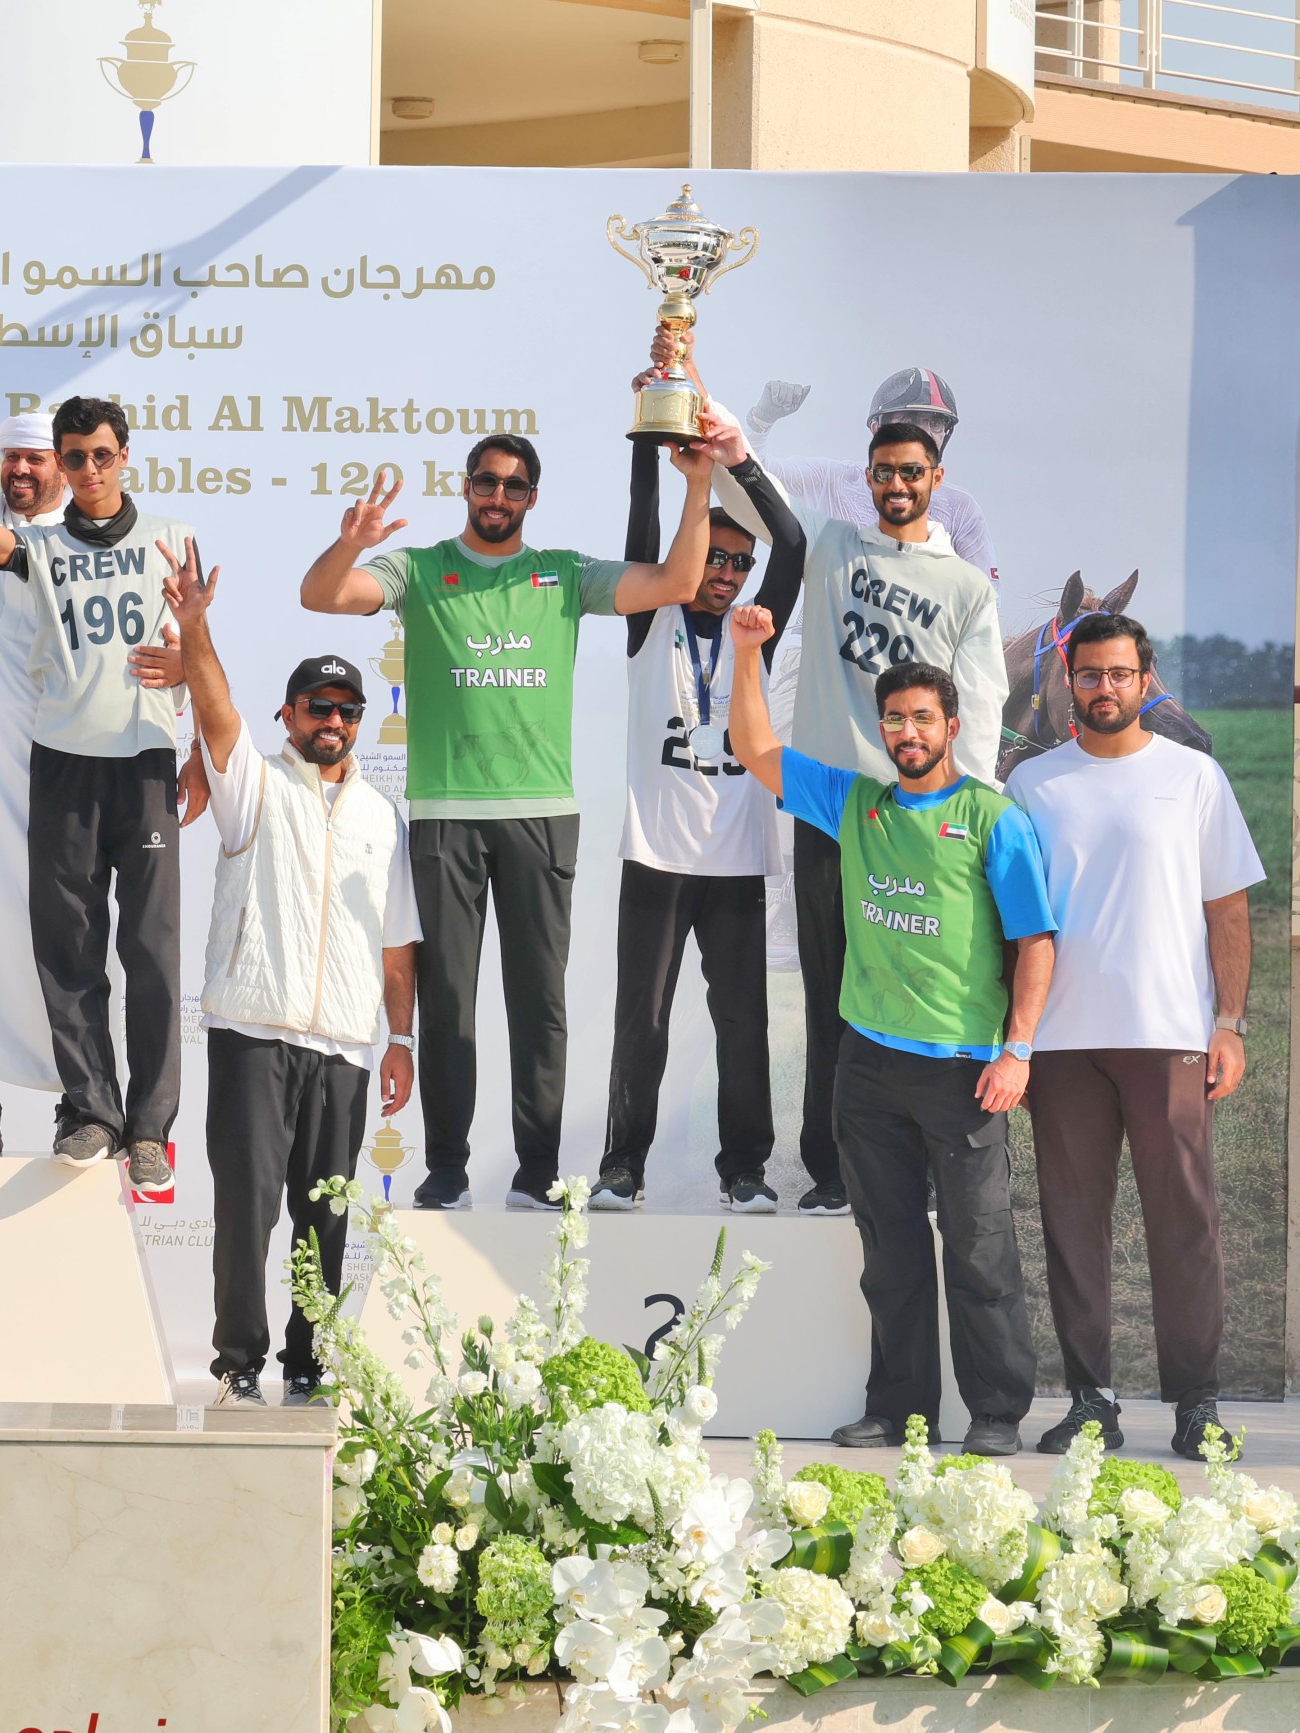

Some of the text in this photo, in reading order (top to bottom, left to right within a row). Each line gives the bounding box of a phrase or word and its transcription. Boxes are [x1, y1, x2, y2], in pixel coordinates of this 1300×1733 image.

[21, 252, 162, 296] السمو
[172, 253, 310, 299] صاحب
[321, 254, 496, 301] مهرجان
[129, 311, 243, 360] سباق
[208, 394, 263, 432] Al
[281, 395, 540, 435] Maktoum
[118, 455, 252, 495] ables
[310, 461, 404, 498] 120
[50, 546, 146, 587] CREW
[850, 567, 942, 632] CREW
[61, 591, 145, 651] 196
[466, 630, 532, 659] مدرب
[838, 610, 915, 676] 229
[320, 659, 347, 677] alo
[450, 668, 548, 688] TRAINER
[362, 774, 393, 783] HEIKH
[867, 872, 926, 898] مدرب
[860, 898, 941, 937] TRAINER
[187, 1235, 214, 1247] CLU
[644, 1293, 686, 1362] 2
